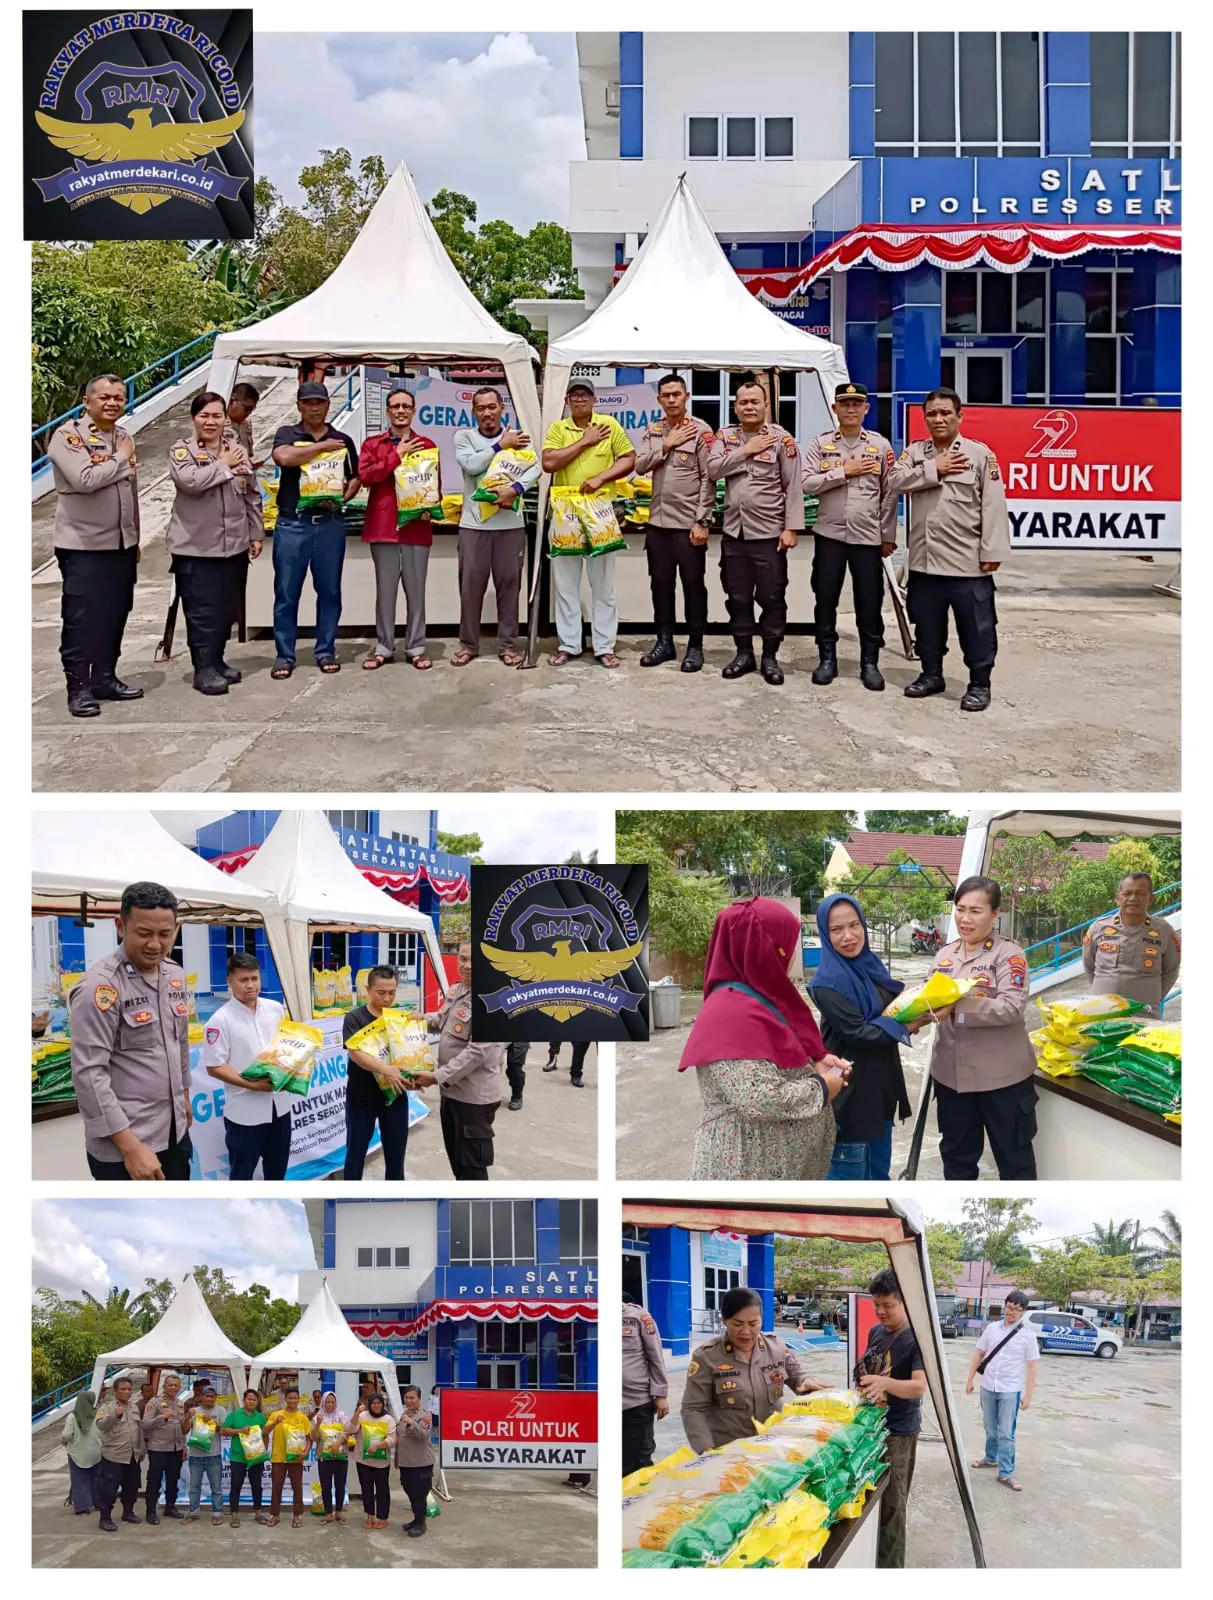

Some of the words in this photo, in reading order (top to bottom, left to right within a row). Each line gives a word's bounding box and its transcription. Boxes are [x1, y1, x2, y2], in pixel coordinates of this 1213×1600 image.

[1040, 169, 1181, 191] SATL
[910, 198, 1078, 214] POLRES
[1004, 463, 1037, 491] RI
[1048, 464, 1154, 492] UNTUK
[1008, 511, 1166, 540] YARAKAT
[291, 1091, 334, 1115] UNTUK
[526, 1271, 598, 1282] SATL
[459, 1286, 545, 1294] POLRES
[461, 1420, 514, 1437] POLRI
[519, 1421, 580, 1438] UNTUK
[453, 1446, 587, 1465] MASYARAKAT
